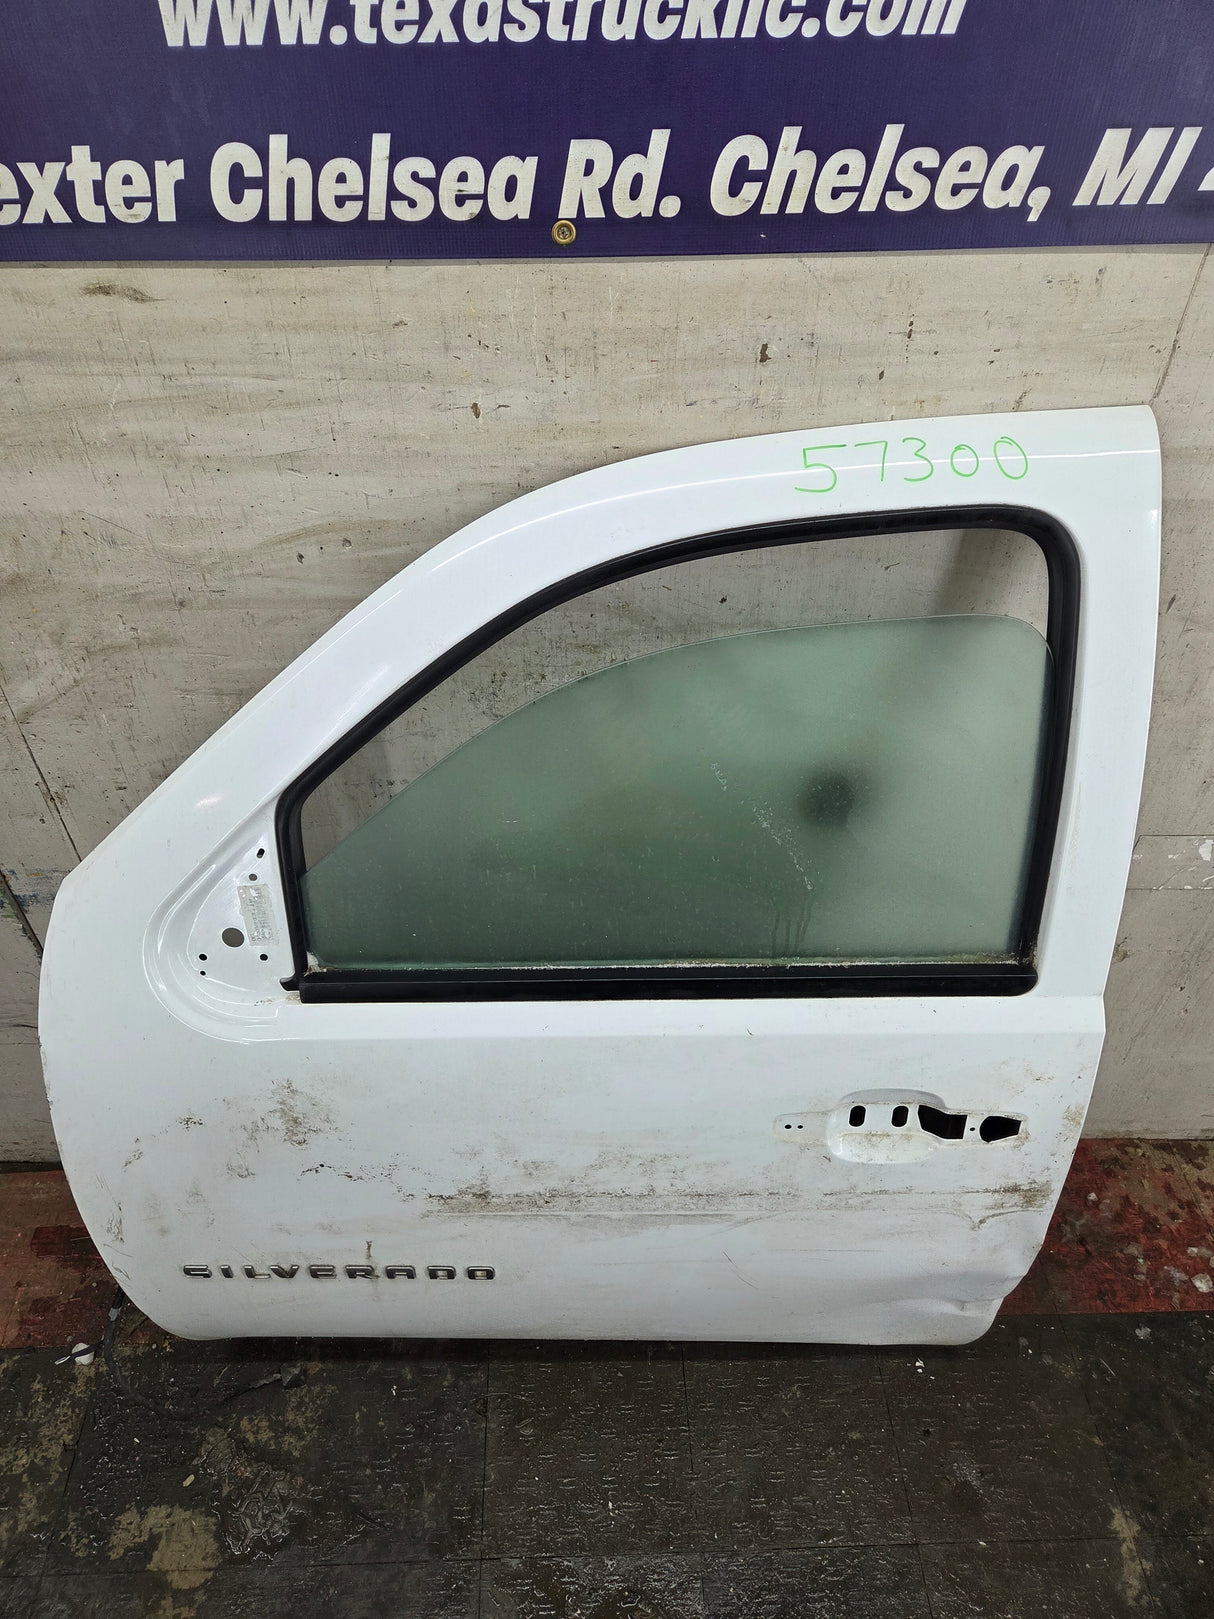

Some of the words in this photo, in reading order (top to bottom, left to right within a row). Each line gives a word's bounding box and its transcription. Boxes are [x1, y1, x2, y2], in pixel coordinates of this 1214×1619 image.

[209, 132, 539, 223] Chelsea
[557, 128, 682, 219] Rd.
[710, 123, 1051, 222] Chelsea,
[1071, 126, 1203, 207] MI
[794, 436, 1028, 493] 57300
[183, 1264, 496, 1280] SILVERADO
